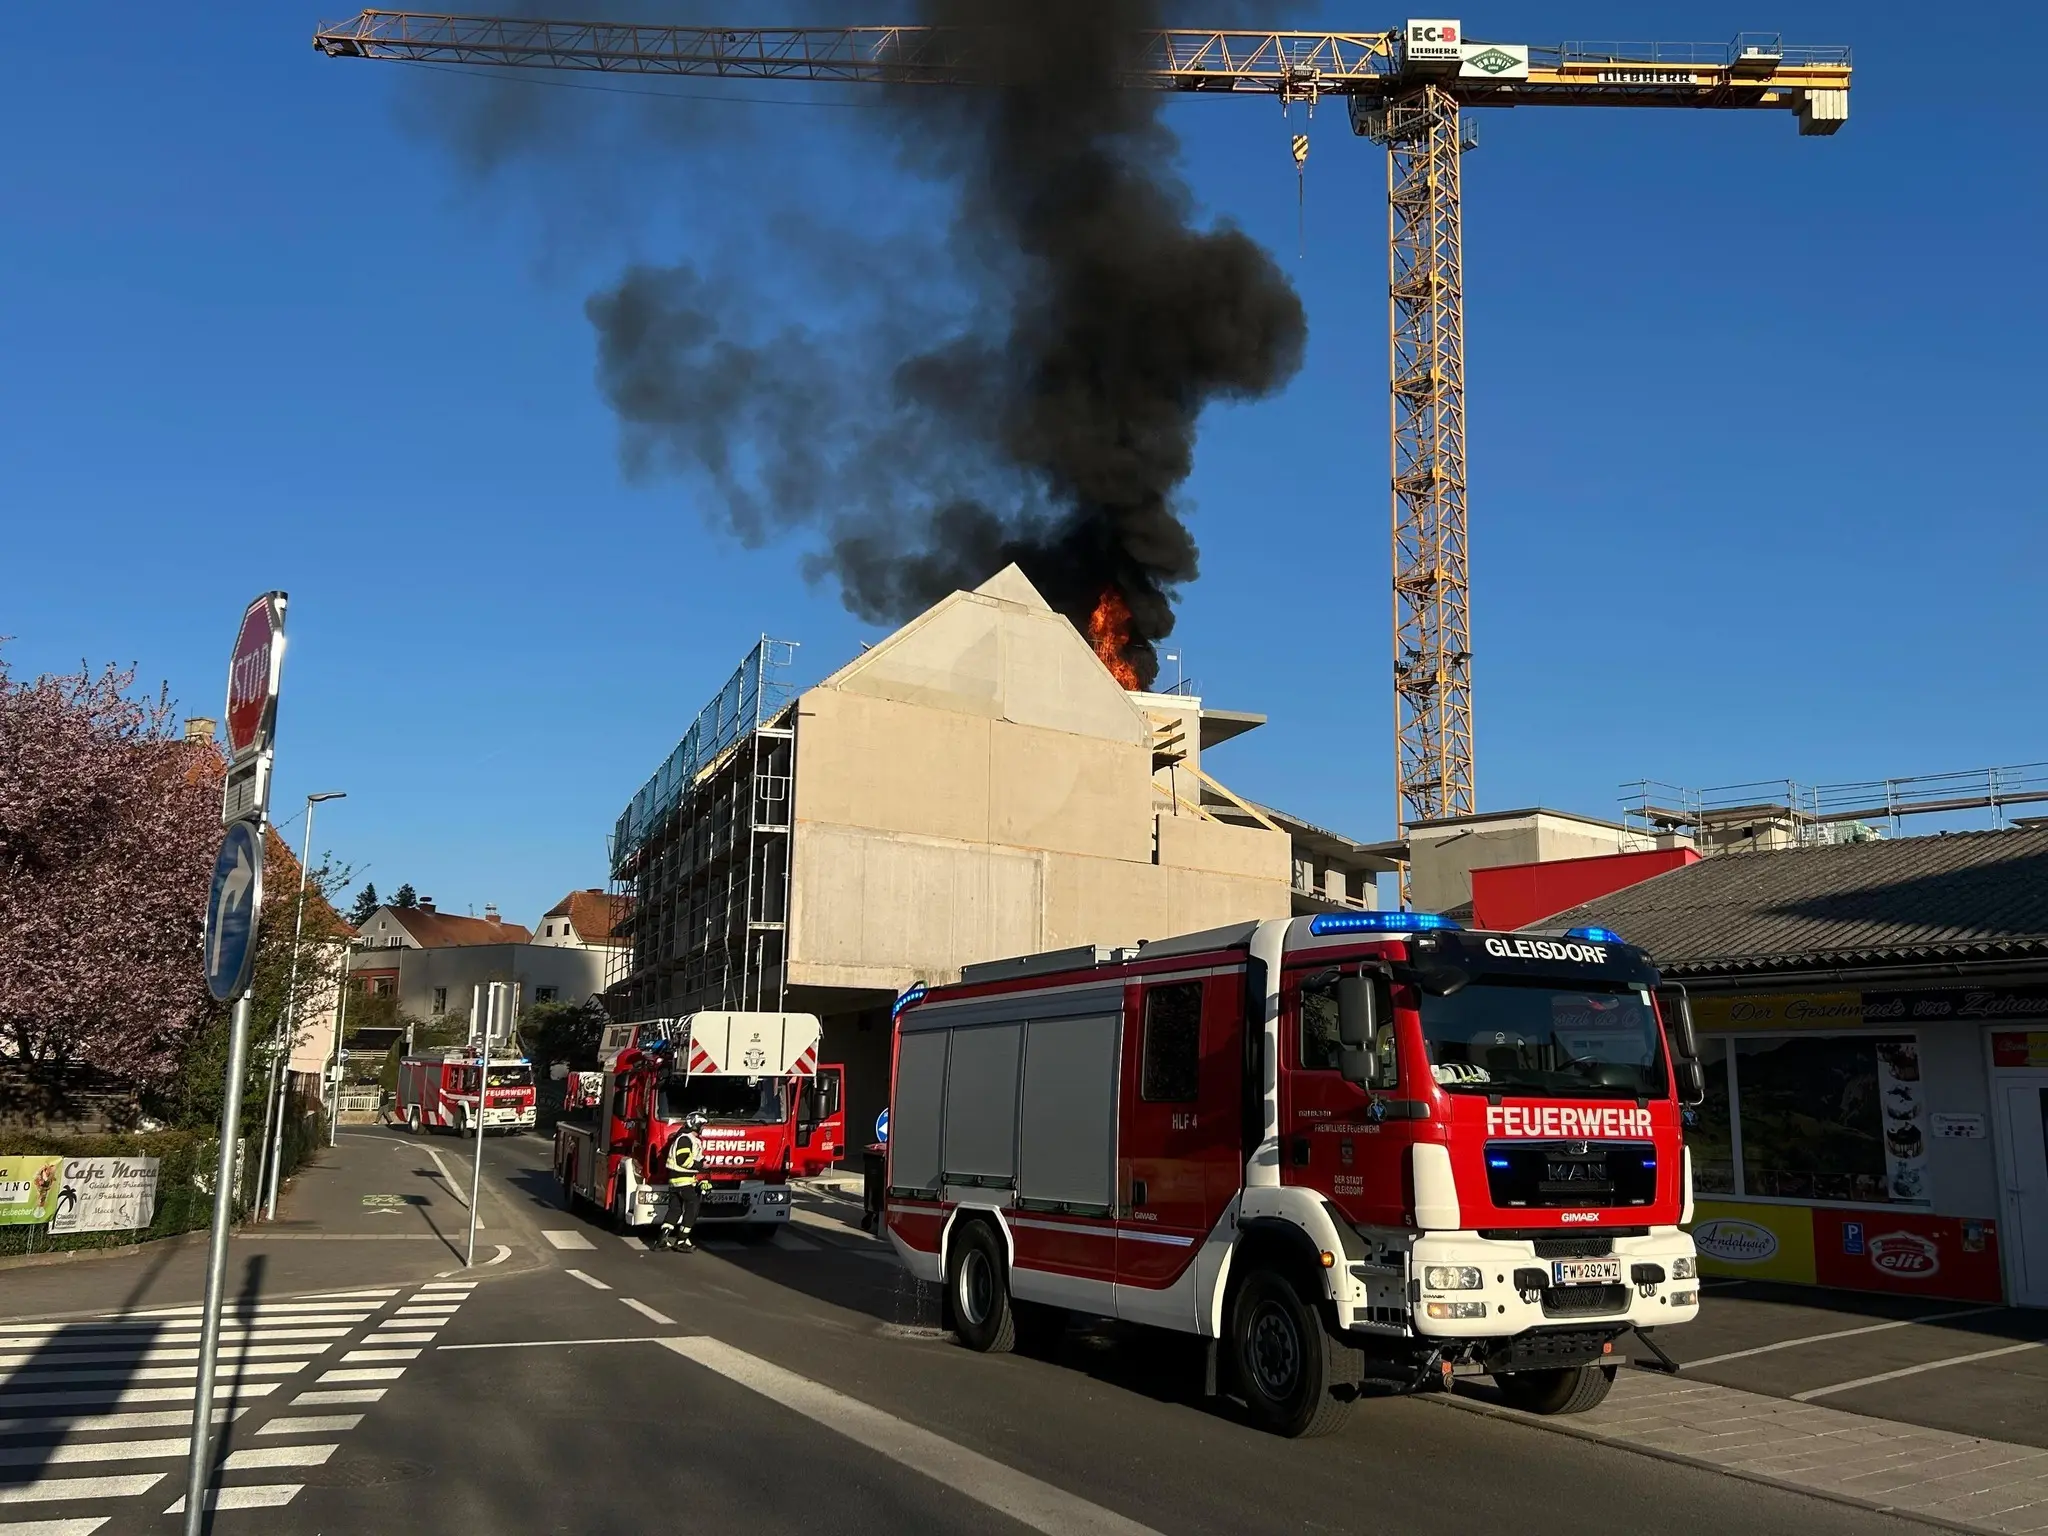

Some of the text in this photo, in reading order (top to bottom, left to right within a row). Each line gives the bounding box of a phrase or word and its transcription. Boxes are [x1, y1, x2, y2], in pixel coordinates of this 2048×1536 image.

[1412, 27, 1456, 42] EC-B
[1476, 57, 1512, 69] GRANIT
[1603, 72, 1692, 83] LIEBHERR
[231, 642, 269, 714] STOP
[1485, 938, 1608, 964] GLEISDORF
[1730, 1000, 1775, 1022] Der
[1785, 998, 1905, 1020] Geschmack
[1912, 999, 1951, 1017] von
[486, 1089, 532, 1097] FEUERWEHR
[1172, 1113, 1198, 1130] HLF 4
[1486, 1106, 1653, 1137] FEUERWEHR
[701, 1128, 746, 1137] MAGIRUS
[1315, 1123, 1380, 1133] FREIWILLIGE FEUERWEHR
[702, 1140, 766, 1151] UERWEHR
[704, 1155, 745, 1165] VECO
[64, 1161, 105, 1183] Café
[1547, 1163, 1607, 1181] MAN
[1334, 1174, 1363, 1185] DER STADT
[0, 1181, 31, 1192] INO
[1334, 1185, 1364, 1195] GLEISDORF
[1134, 1211, 1158, 1221] GIMAEX
[1405, 1214, 1412, 1225] 5
[1561, 1212, 1600, 1223] GIMAEX
[1698, 1223, 1766, 1250] Andalusia
[1848, 1224, 1858, 1239] P
[1880, 1253, 1924, 1269] elit
[1563, 1264, 1577, 1279] FW
